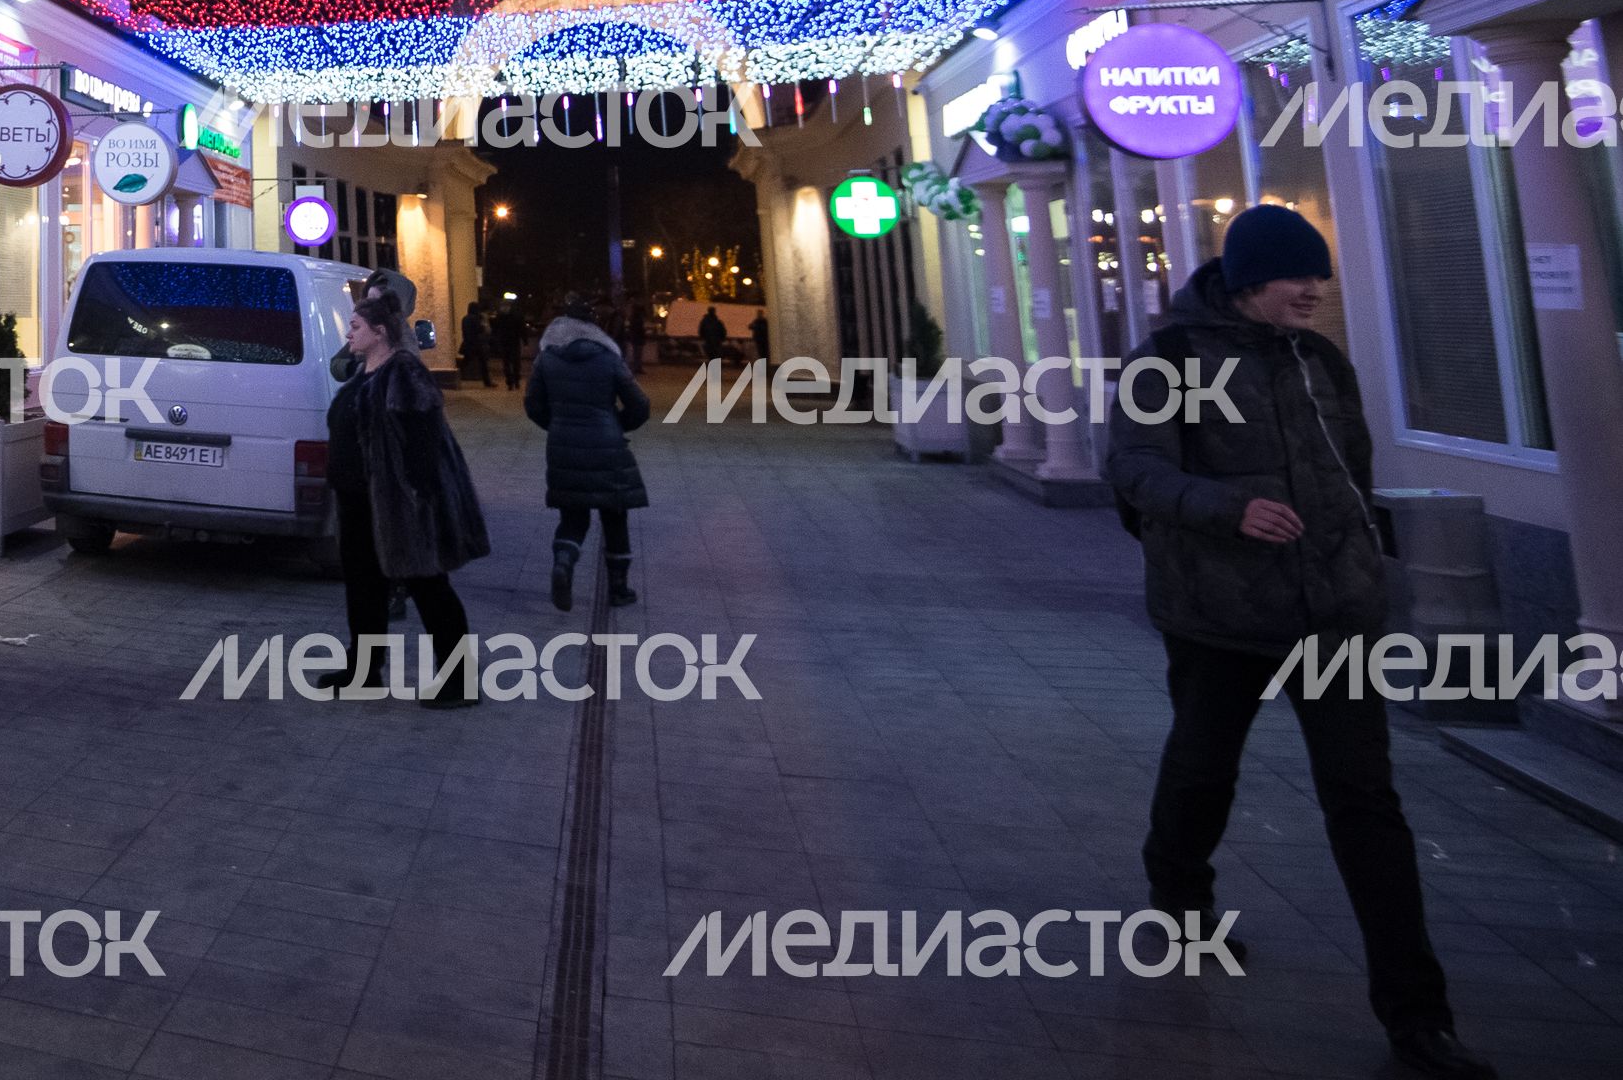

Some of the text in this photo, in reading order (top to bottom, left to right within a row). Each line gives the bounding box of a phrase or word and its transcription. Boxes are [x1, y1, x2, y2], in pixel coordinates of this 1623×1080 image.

[1100, 66, 1220, 86] НАПИТКИ
[1109, 95, 1215, 115] ФРУКТЫ
[108, 139, 157, 149] ВО ИМЯ
[105, 152, 160, 168] РОЗЫ
